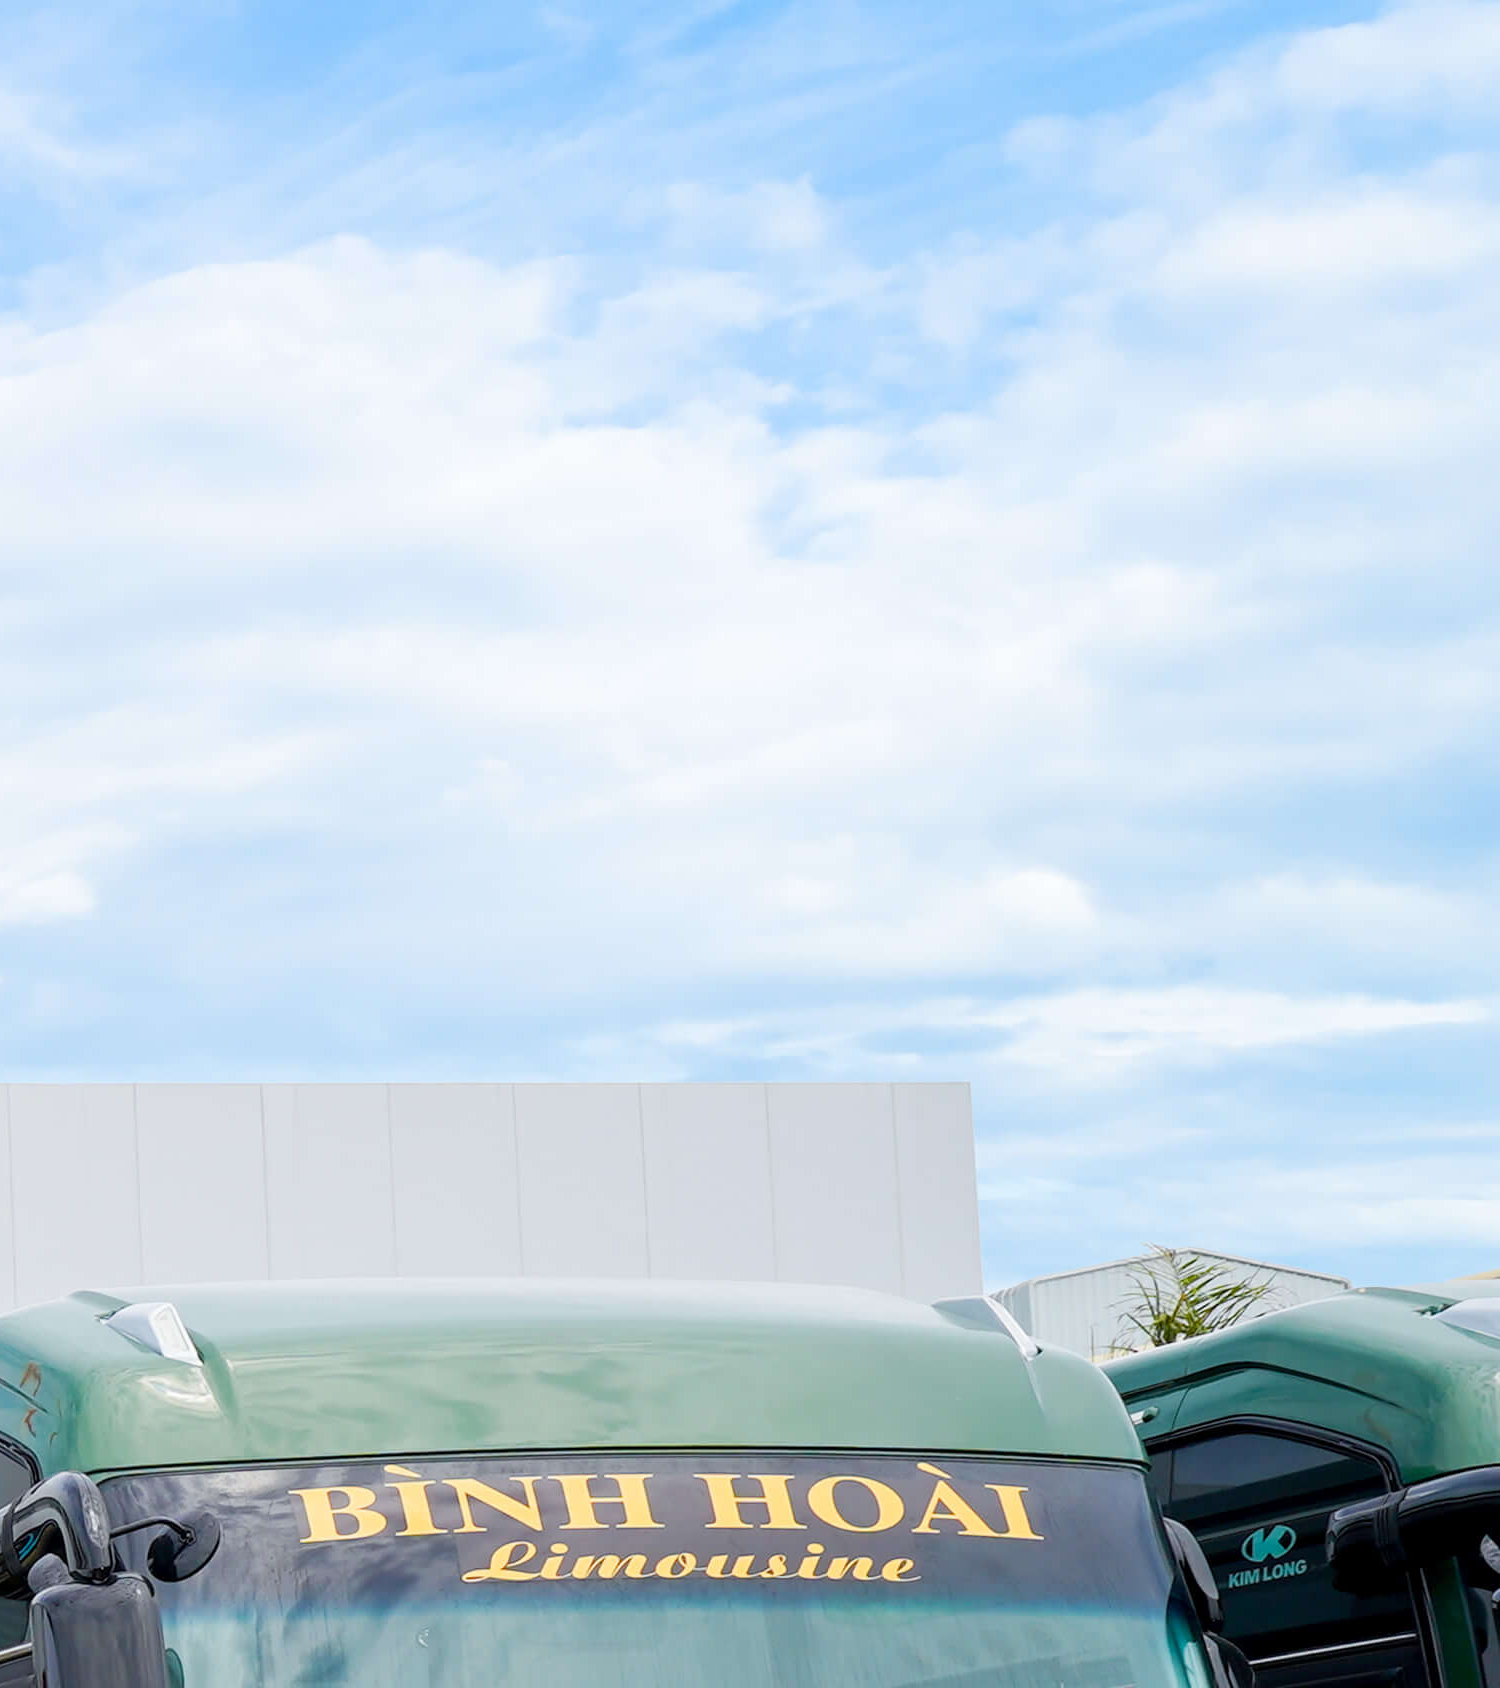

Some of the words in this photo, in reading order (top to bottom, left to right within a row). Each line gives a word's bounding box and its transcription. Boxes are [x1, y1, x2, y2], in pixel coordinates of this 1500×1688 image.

[289, 1463, 665, 1543] BÌNH
[694, 1463, 1043, 1541] HOÀI
[460, 1540, 922, 1586] Limousine
[1228, 1570, 1260, 1588] KIM
[1263, 1559, 1308, 1580] LONG
